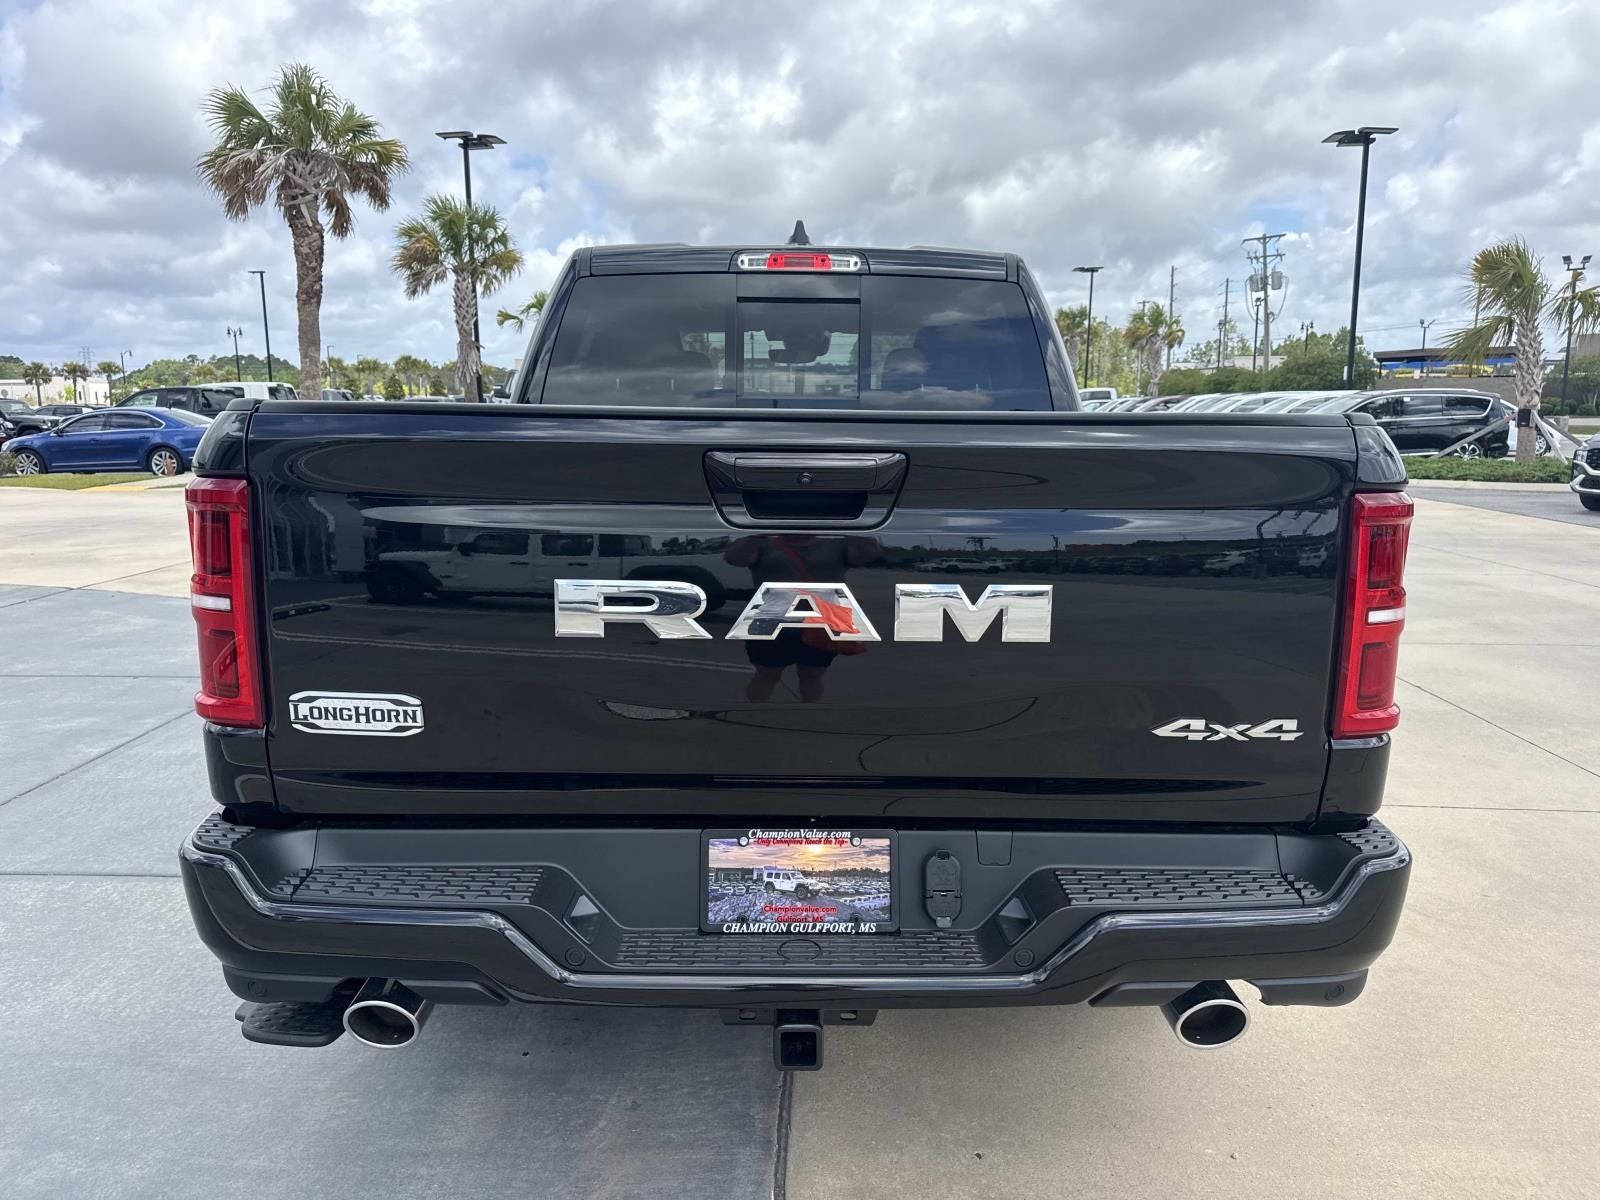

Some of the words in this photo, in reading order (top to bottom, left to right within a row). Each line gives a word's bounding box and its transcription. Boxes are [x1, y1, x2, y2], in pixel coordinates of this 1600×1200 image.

[554, 579, 1053, 642] RAM
[292, 703, 420, 724] LONGHORN
[1151, 718, 1305, 741] 4x4
[748, 828, 851, 840] ChampionValue.com
[763, 905, 837, 914] Championvalue.com
[723, 922, 788, 933] CHAMPION
[790, 922, 856, 934] GULFPORT,
[858, 922, 877, 933] MS
